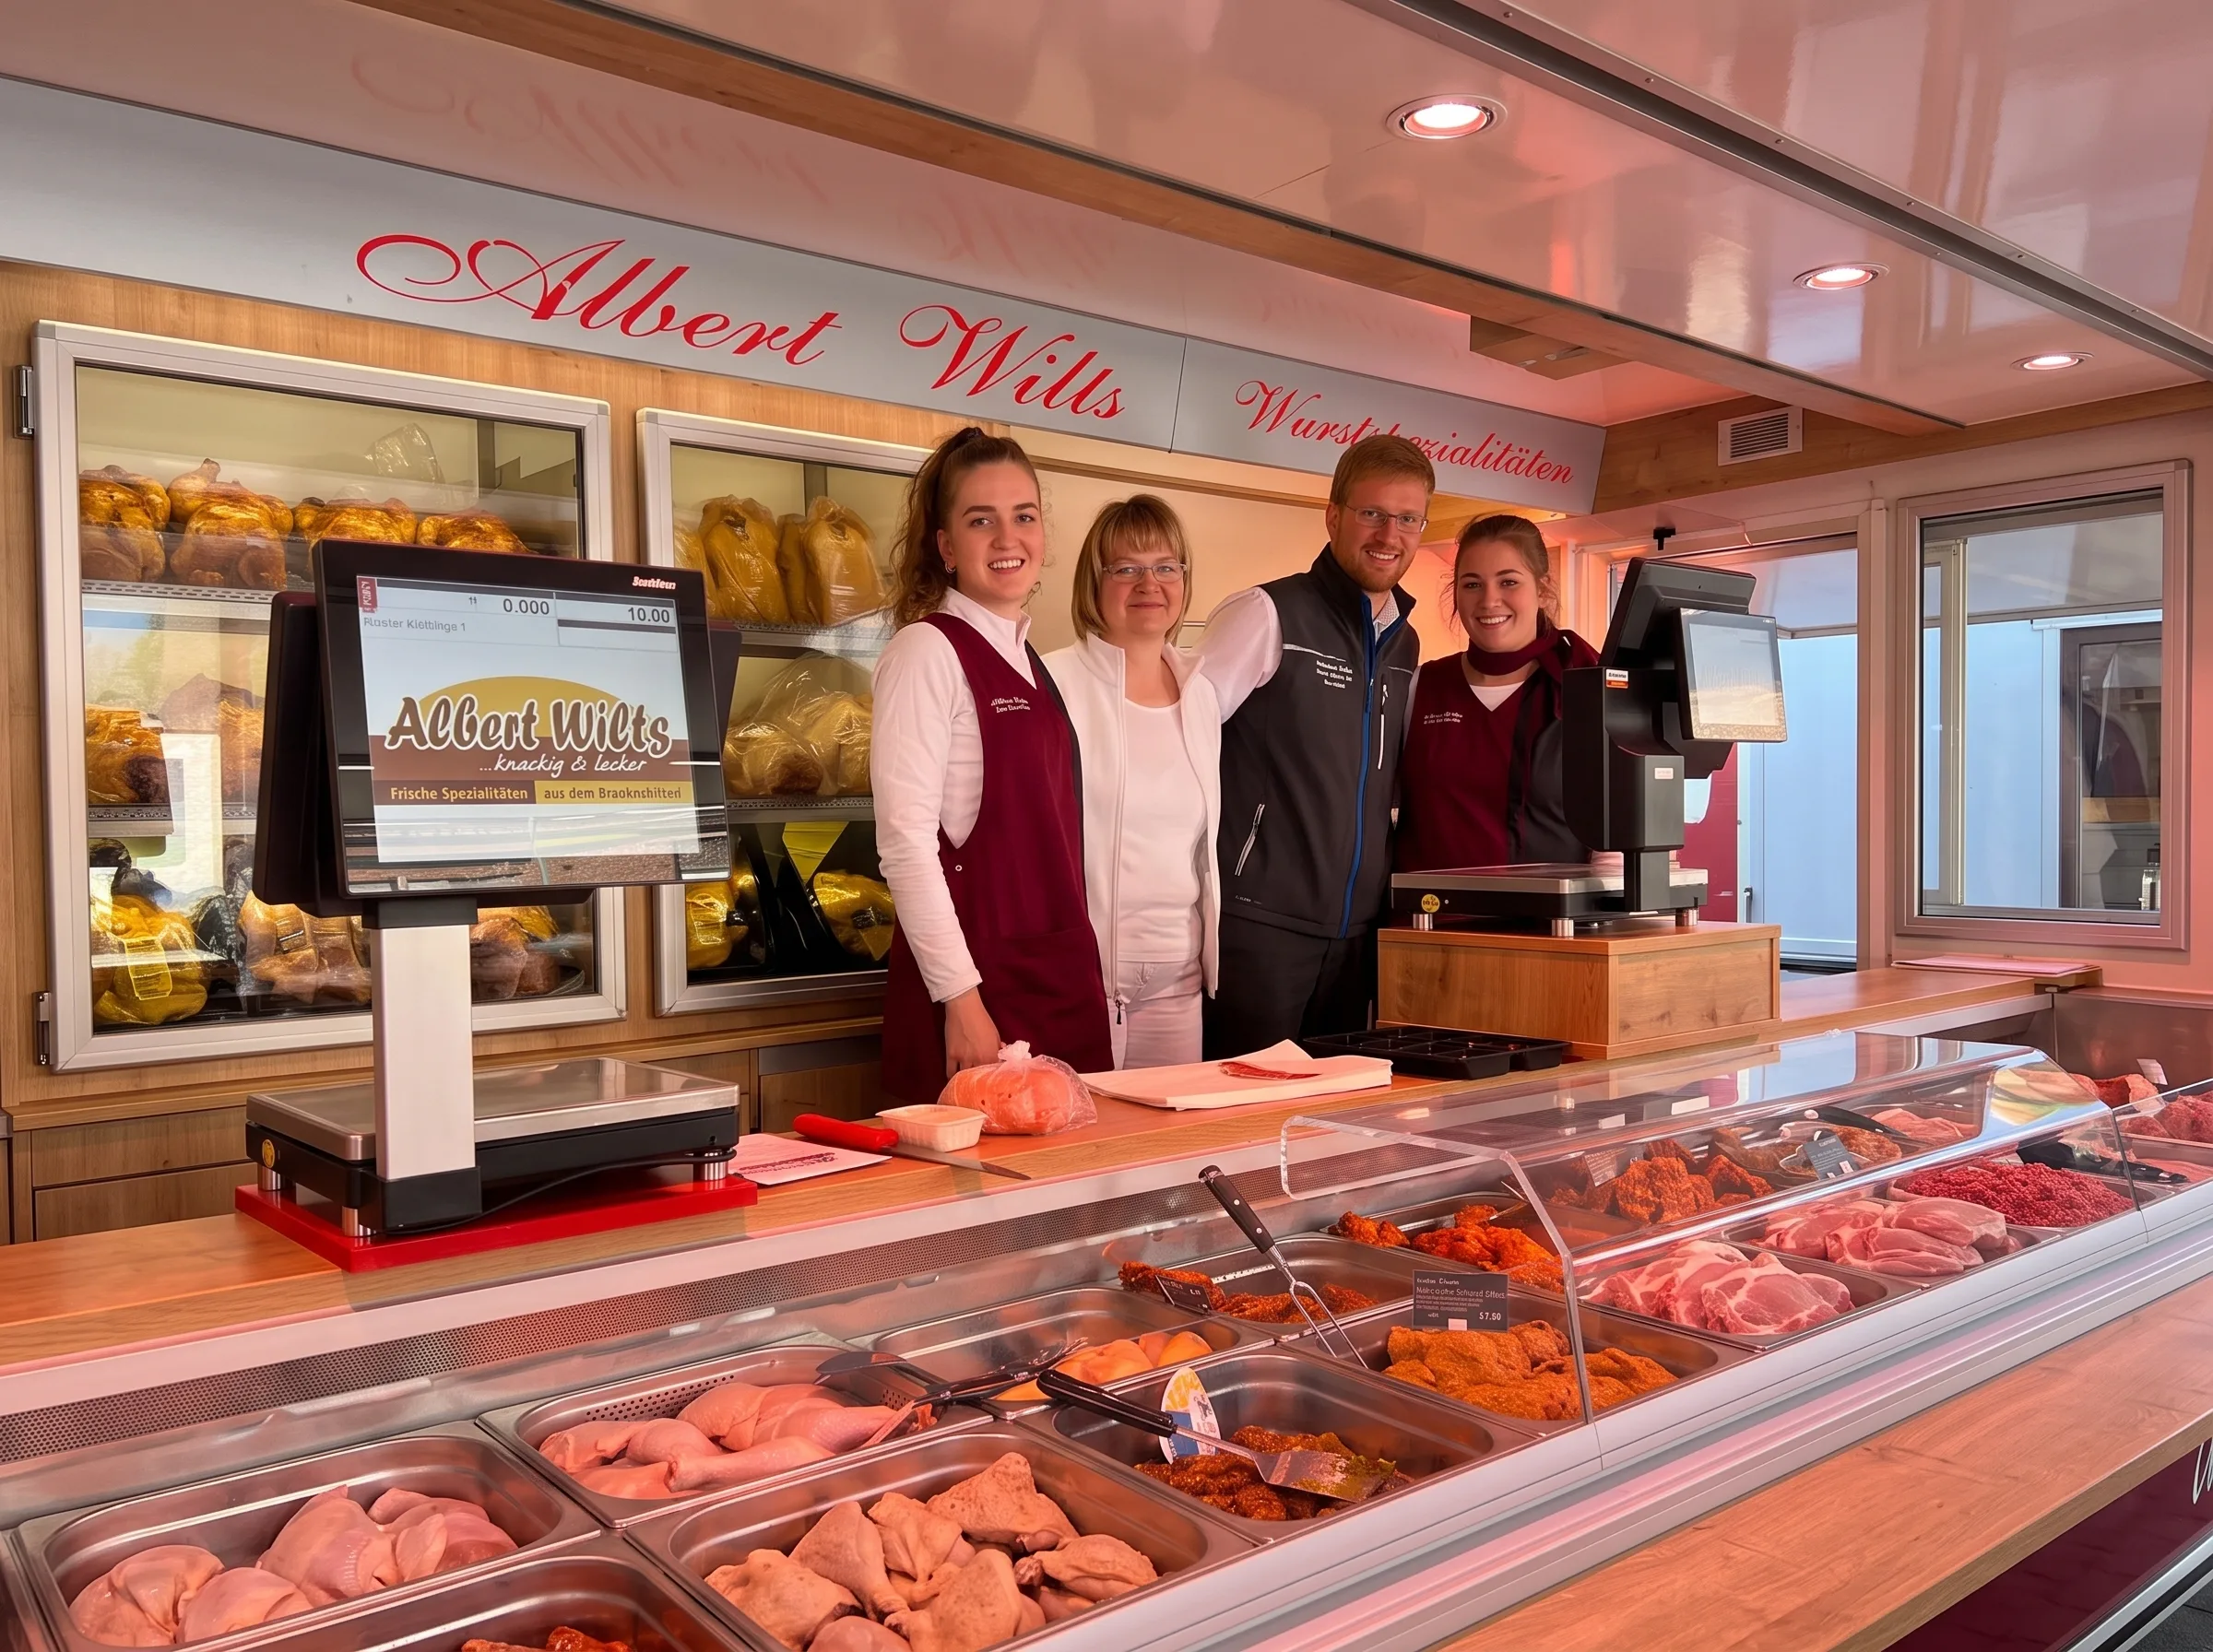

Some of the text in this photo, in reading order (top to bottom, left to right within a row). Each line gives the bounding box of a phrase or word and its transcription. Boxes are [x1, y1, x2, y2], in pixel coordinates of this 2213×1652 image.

[356, 234, 1124, 419] Albert Wills
[1235, 380, 1574, 484] Wurstezialitäten
[503, 598, 670, 623] 0.000 10.00
[385, 694, 672, 758] Albert Wilts
[571, 758, 586, 772] &
[595, 754, 647, 772] lecker
[390, 785, 528, 803] Frische Spezialitäten
[544, 789, 565, 799] aus
[569, 786, 595, 799] dem
